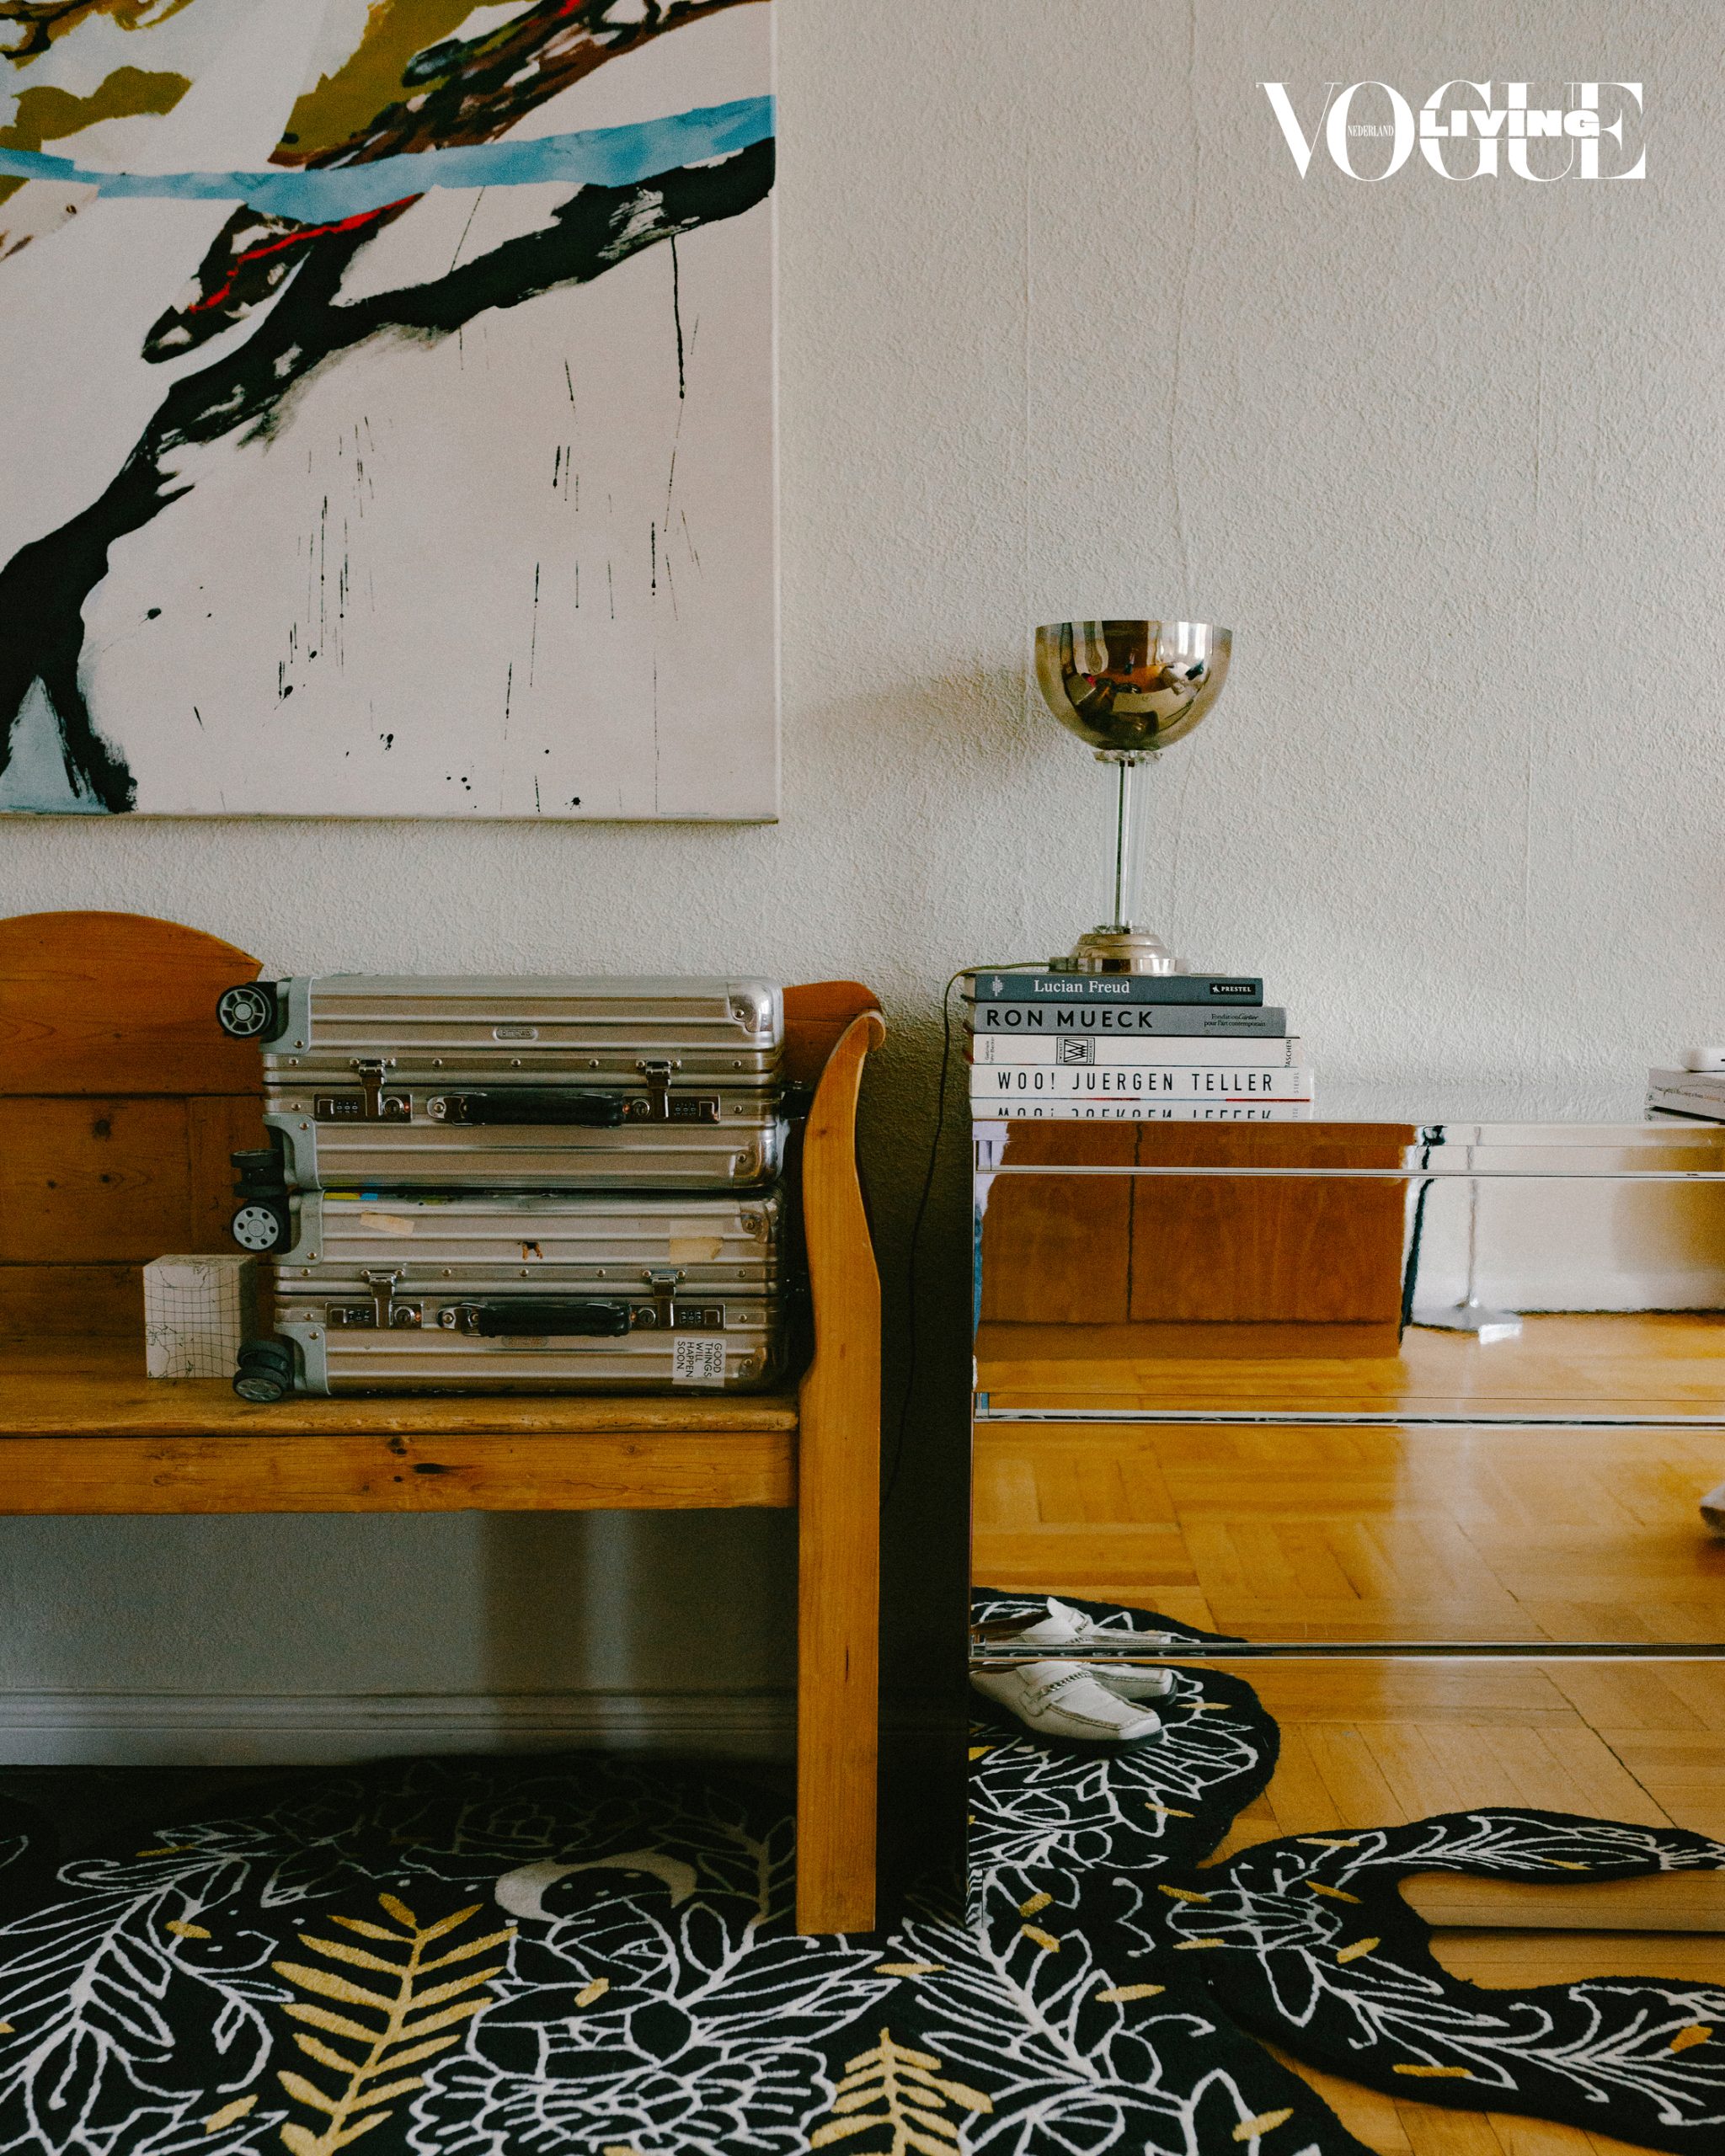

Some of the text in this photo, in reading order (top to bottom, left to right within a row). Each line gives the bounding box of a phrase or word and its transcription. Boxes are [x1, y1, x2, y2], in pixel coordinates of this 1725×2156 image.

[1033, 979, 1130, 994] Lucian Freud
[986, 1009, 1153, 1028] RON MUECK
[997, 1071, 1273, 1091] WOO! JUERGEN TELLER
[676, 1341, 686, 1372] SOON.
[686, 1342, 695, 1378] HAPPEN
[695, 1342, 704, 1363] WILL
[703, 1342, 713, 1378] THINGS
[713, 1342, 723, 1374] GOOD
